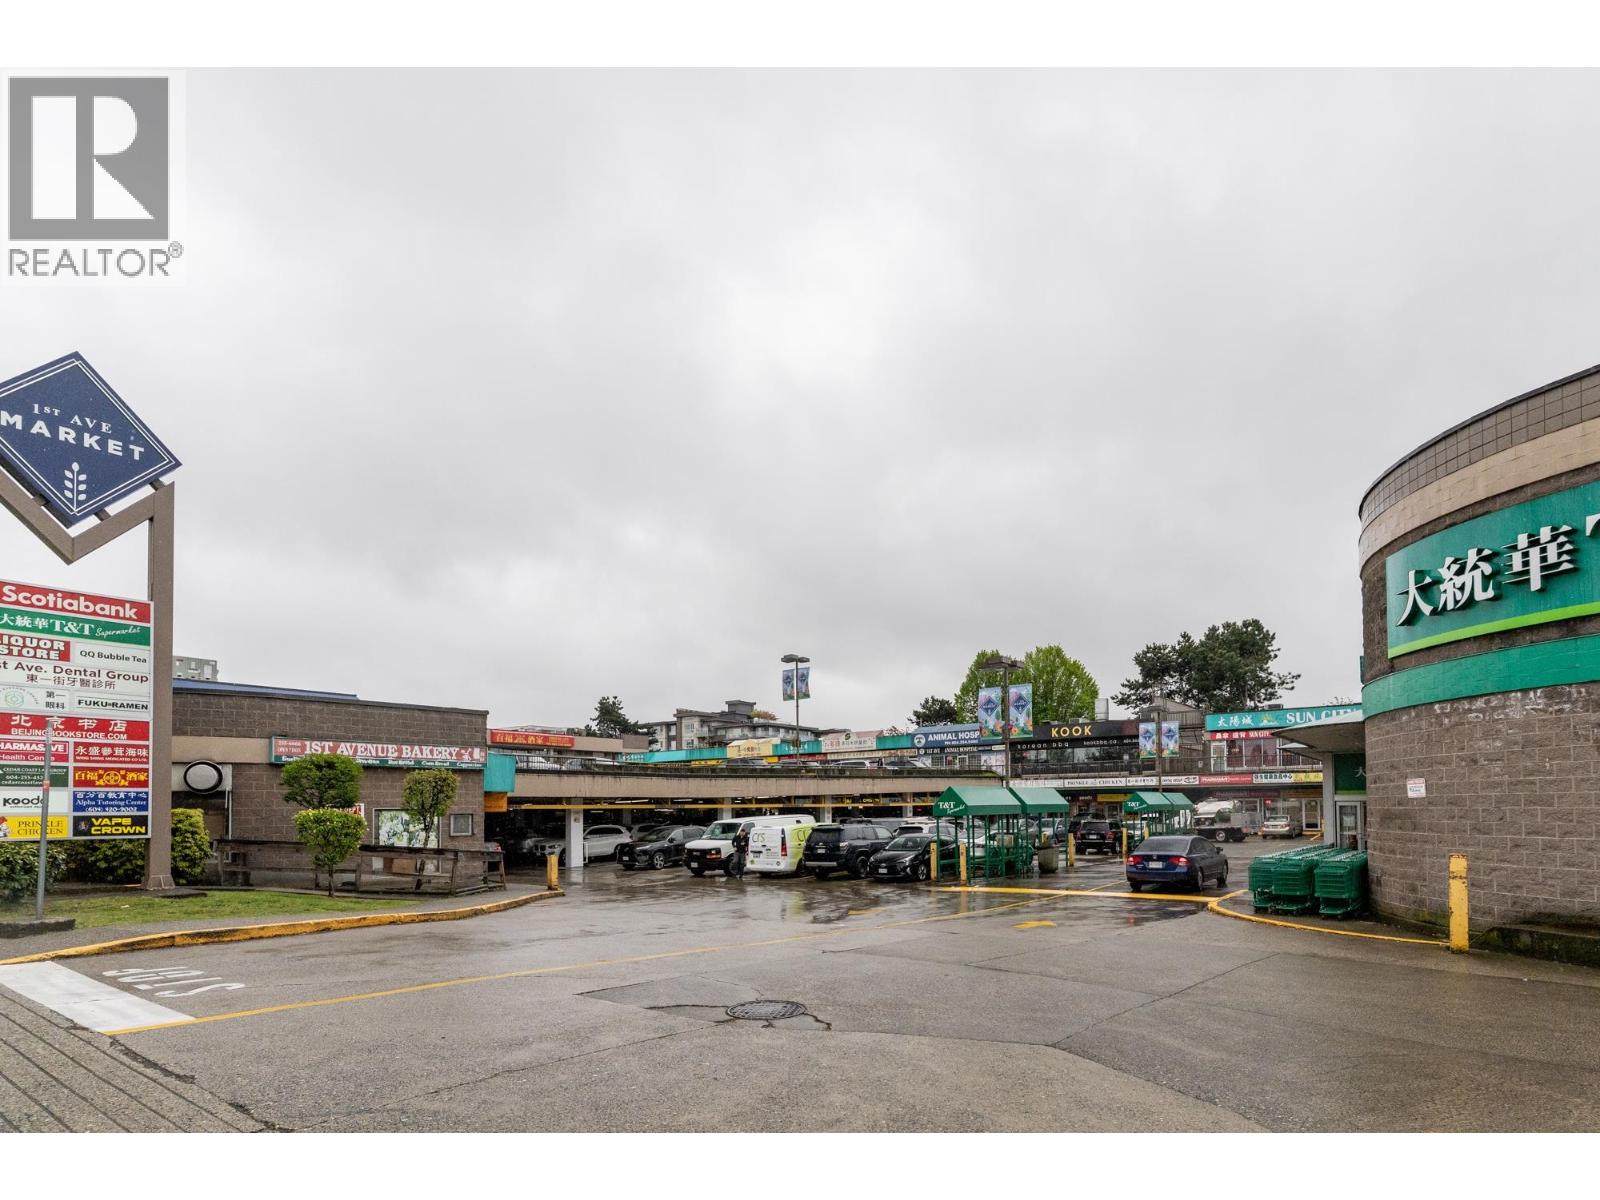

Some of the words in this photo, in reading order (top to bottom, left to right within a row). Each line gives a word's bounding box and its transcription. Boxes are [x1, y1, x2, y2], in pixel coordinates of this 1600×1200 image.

[32, 403, 61, 416] 1ST
[70, 414, 112, 434] AVE
[0, 410, 145, 461] MARKET
[1395, 524, 1577, 628] 大統華
[2, 585, 138, 619] Scotiabank
[0, 634, 65, 651] IQUOR
[79, 650, 96, 659] QQ
[97, 651, 130, 662] Bubble
[132, 655, 147, 664] Tea
[14, 661, 48, 673] Ave.
[53, 665, 101, 678] Dental
[106, 670, 149, 684] Group
[1217, 714, 1255, 727] 太陽城
[1285, 711, 1317, 724] SUN
[928, 732, 957, 742] ANIMAL
[958, 730, 980, 740] HOSP
[1051, 725, 1093, 738] KOOK
[304, 740, 333, 754] 1ST
[337, 742, 398, 758] AVENUE
[401, 744, 460, 760] BAKERY
[938, 801, 956, 809] T&T
[18, 820, 64, 828] PRINLE
[91, 817, 132, 826] VAPE
[91, 825, 146, 834] CROWN
